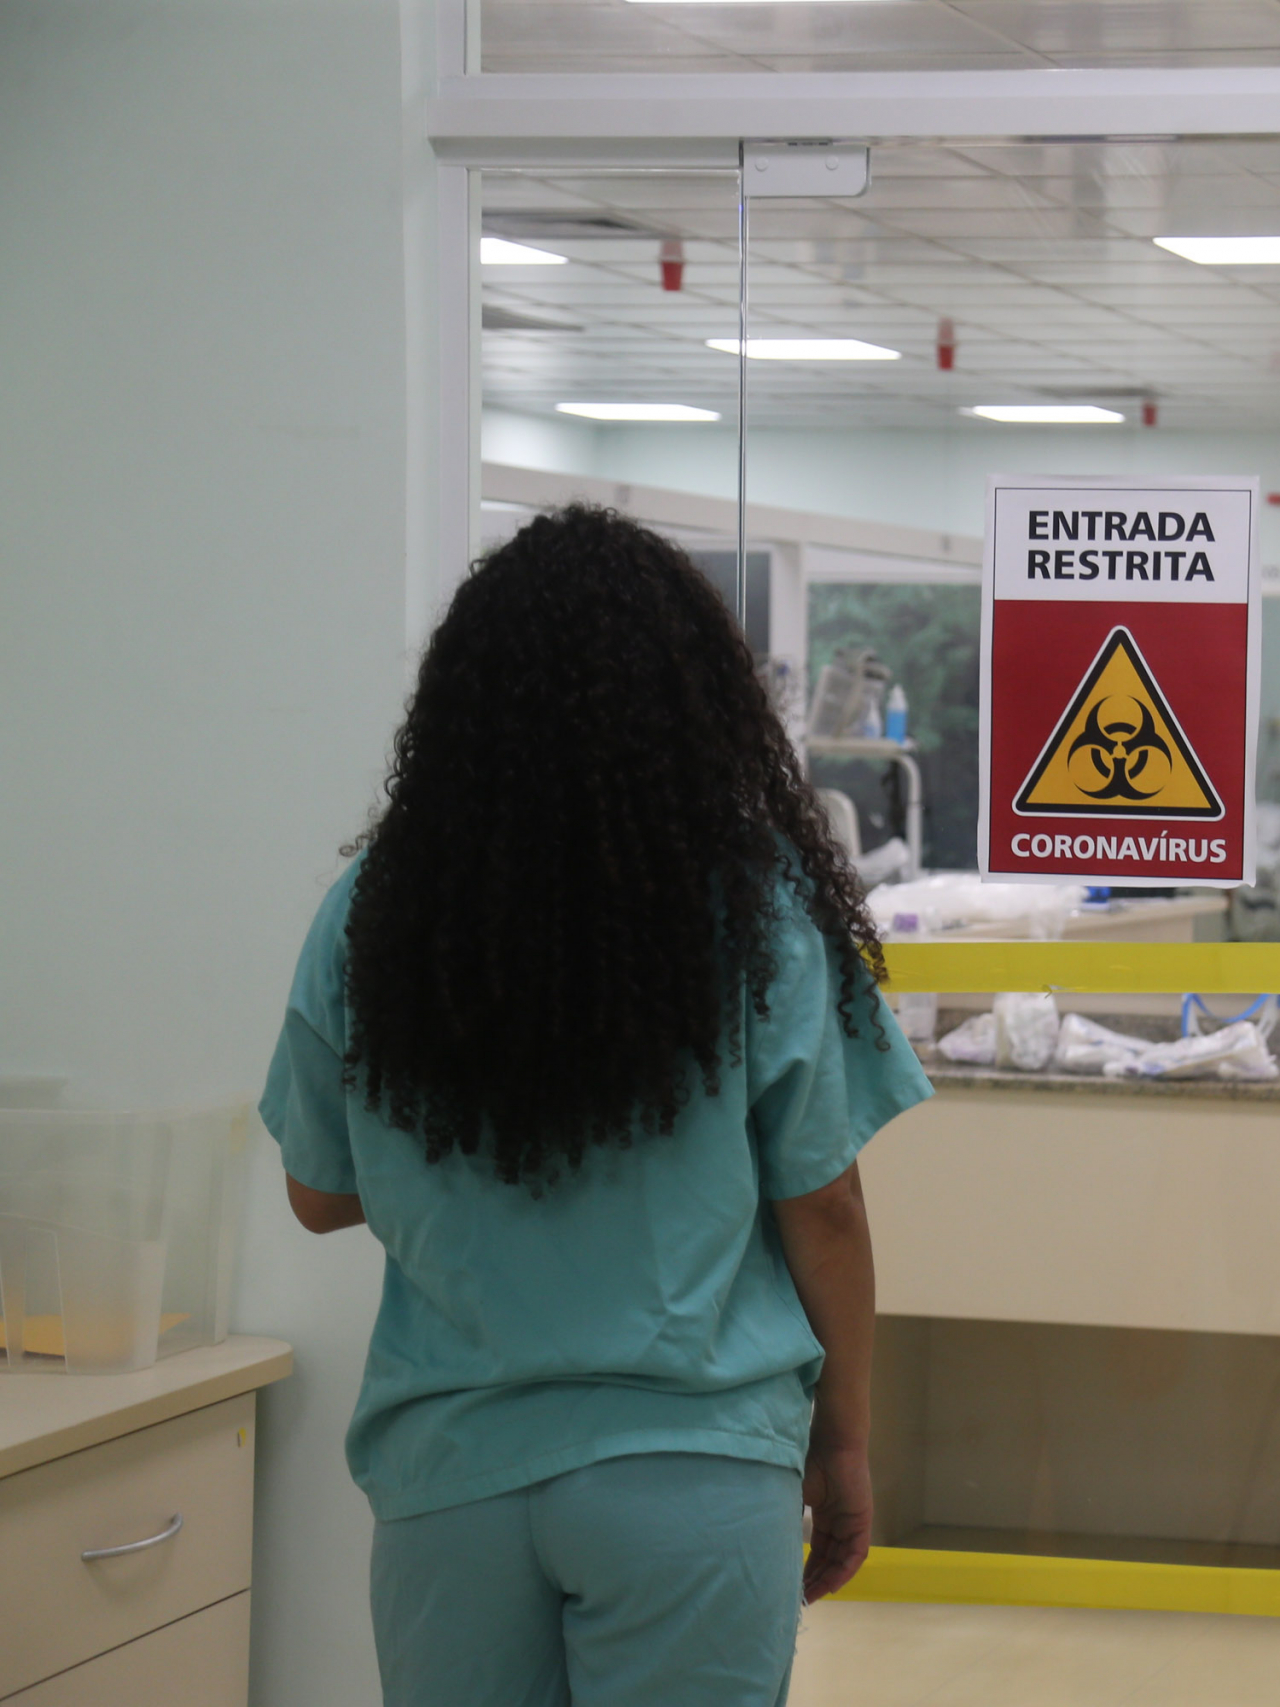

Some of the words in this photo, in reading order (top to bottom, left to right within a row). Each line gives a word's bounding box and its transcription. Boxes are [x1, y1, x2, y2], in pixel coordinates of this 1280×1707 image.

[1028, 510, 1216, 542] ENTRADA
[1027, 550, 1215, 582] RESTRITA
[1010, 830, 1227, 863] CORONAVÍRUS
